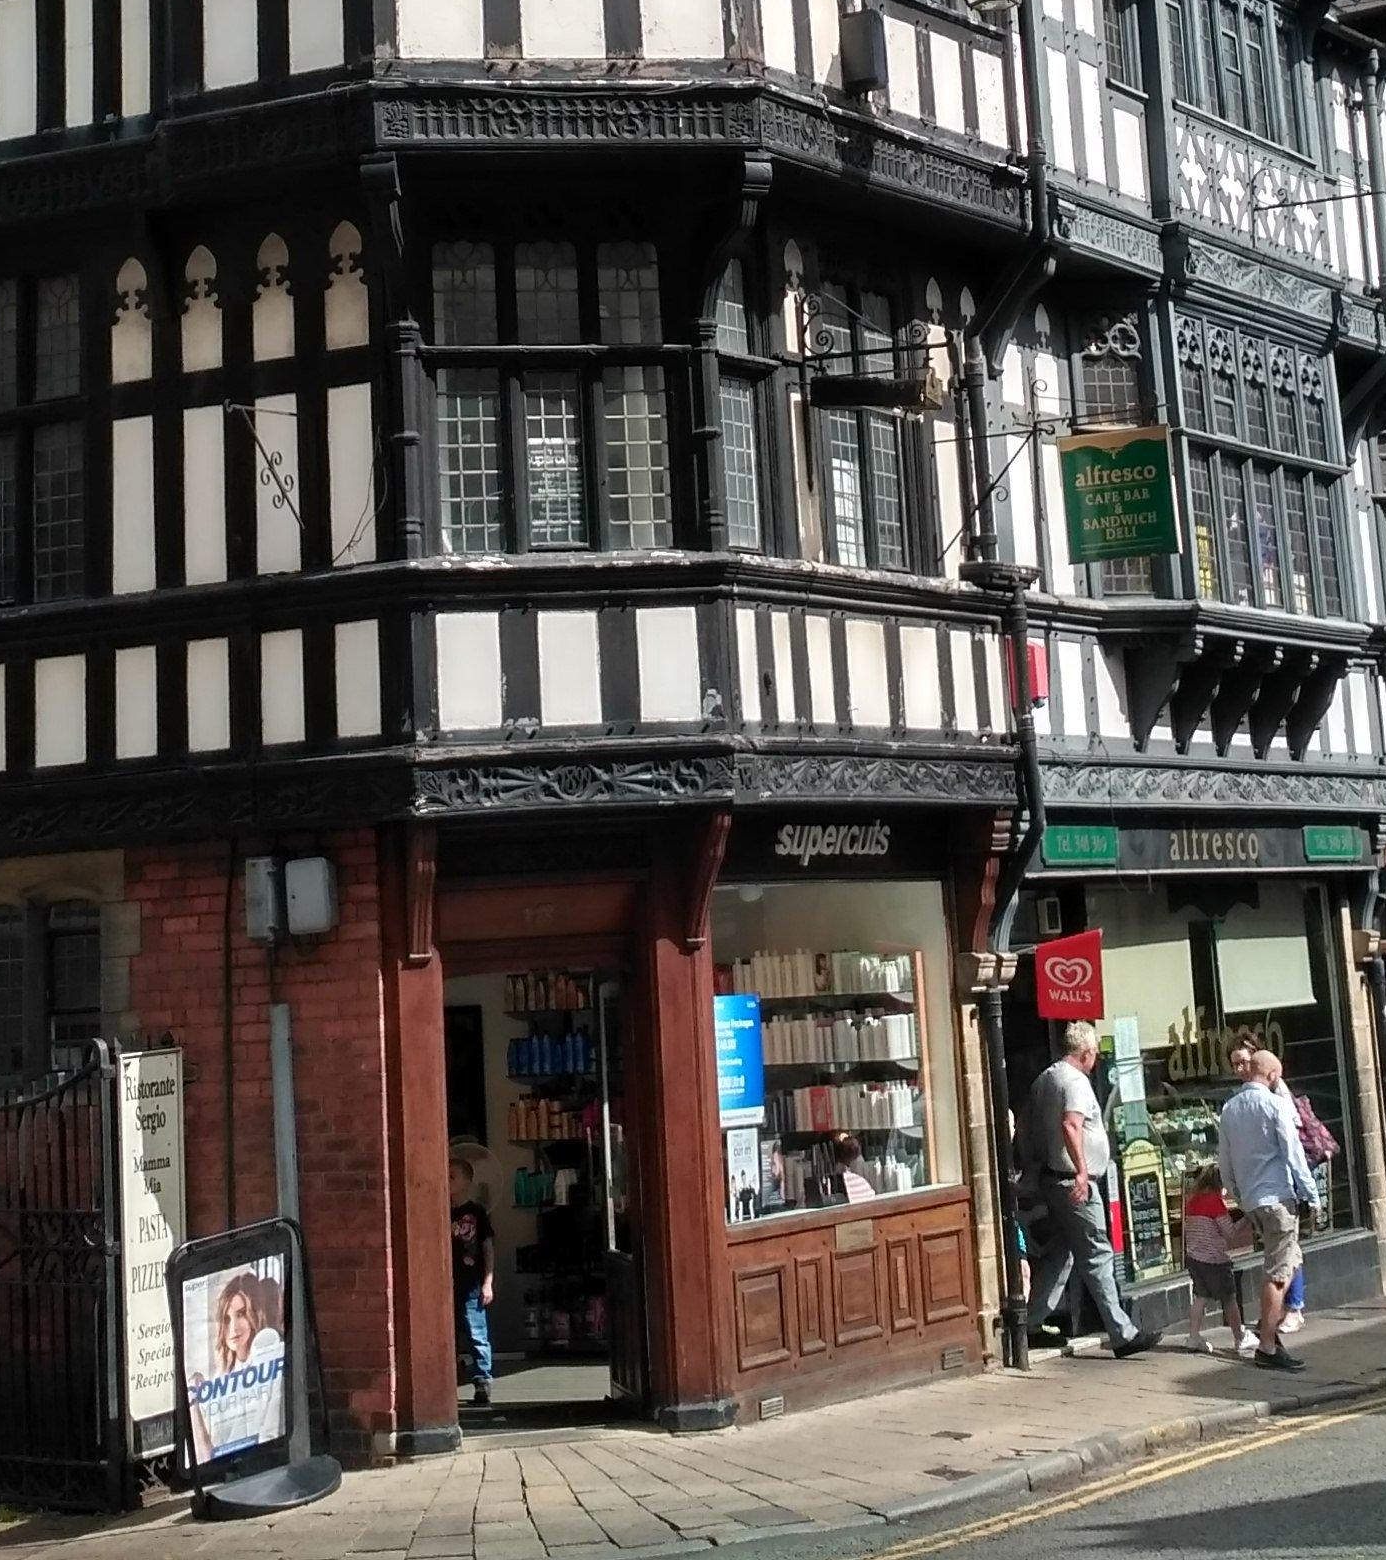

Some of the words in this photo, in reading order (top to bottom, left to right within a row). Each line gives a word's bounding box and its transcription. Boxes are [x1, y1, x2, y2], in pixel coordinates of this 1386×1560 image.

[1075, 465, 1156, 488] alfresco
[1085, 490, 1121, 505] CAFE
[1124, 488, 1150, 502] BAR
[1114, 502, 1123, 515] &
[1082, 511, 1158, 530] SANDWICH
[1106, 526, 1137, 540] DELI
[775, 819, 891, 866] supercuts
[1170, 821, 1260, 861] alfresco
[1048, 989, 1092, 1003] WALL'S
[125, 1075, 175, 1101] Ristorante
[135, 1105, 166, 1135] Sergio
[133, 1154, 171, 1173] Mamma
[144, 1176, 162, 1195] Mia
[139, 1212, 169, 1244] PASTA
[202, 1393, 239, 1418] YOUR
